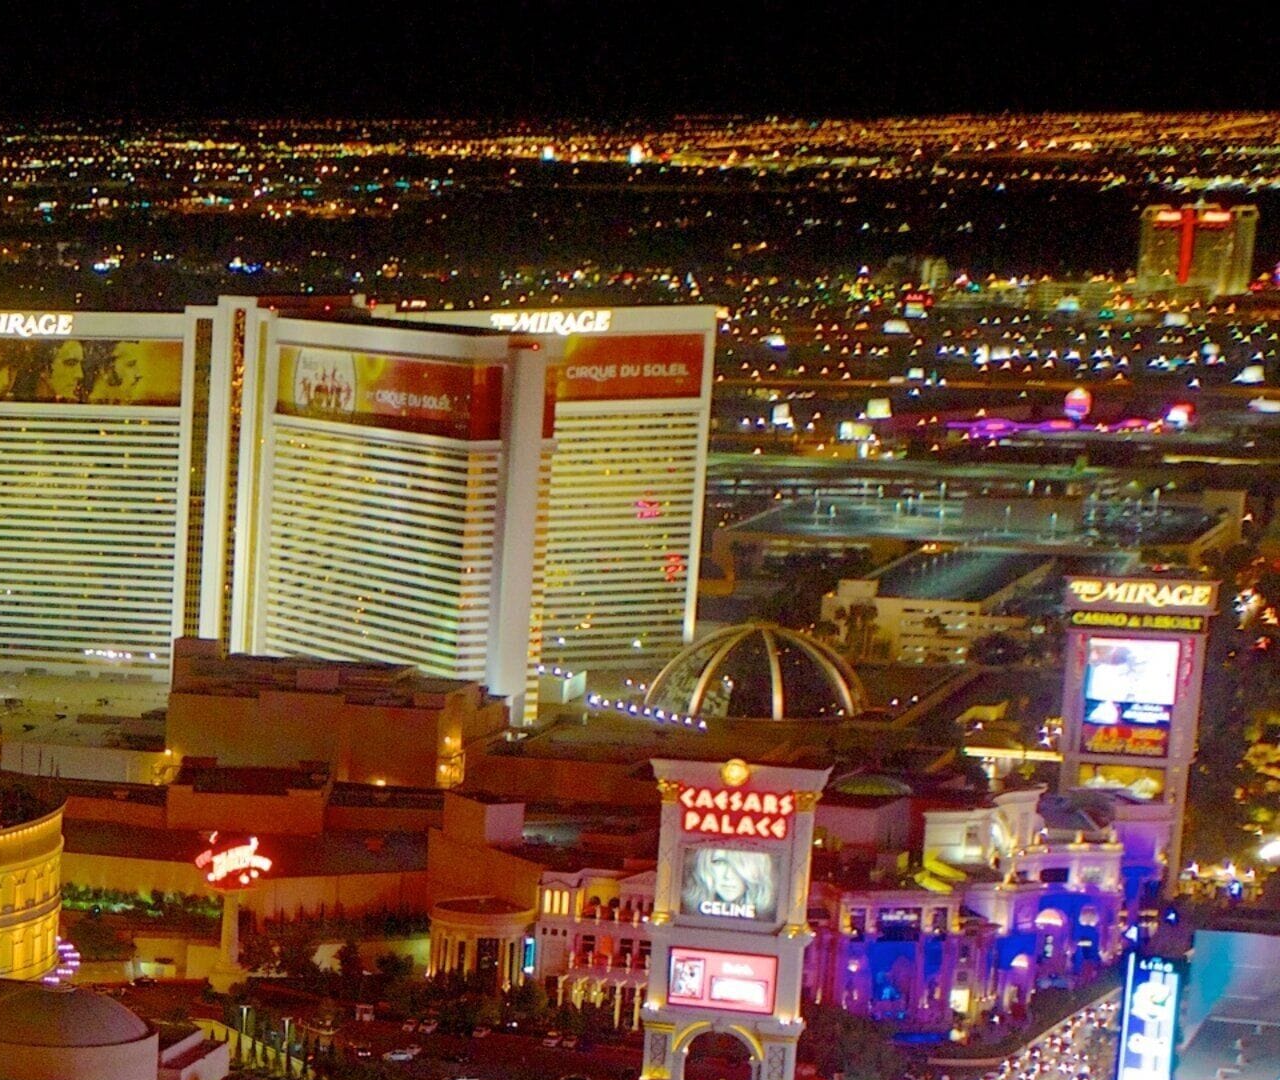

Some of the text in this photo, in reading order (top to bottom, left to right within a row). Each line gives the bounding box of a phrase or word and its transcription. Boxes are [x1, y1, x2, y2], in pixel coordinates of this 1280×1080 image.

[512, 310, 612, 335] MIRAGE
[566, 363, 688, 381] CIRQUE DU SOLEIL
[376, 390, 408, 409] CIRQUE
[408, 393, 421, 407] DU
[1080, 581, 1212, 607] MIRAGE
[1072, 611, 1128, 627] CASINO
[1142, 615, 1203, 631] RESORT
[680, 787, 794, 816] CAESARS
[685, 810, 786, 838] PALACE
[699, 900, 756, 919] CELINE
